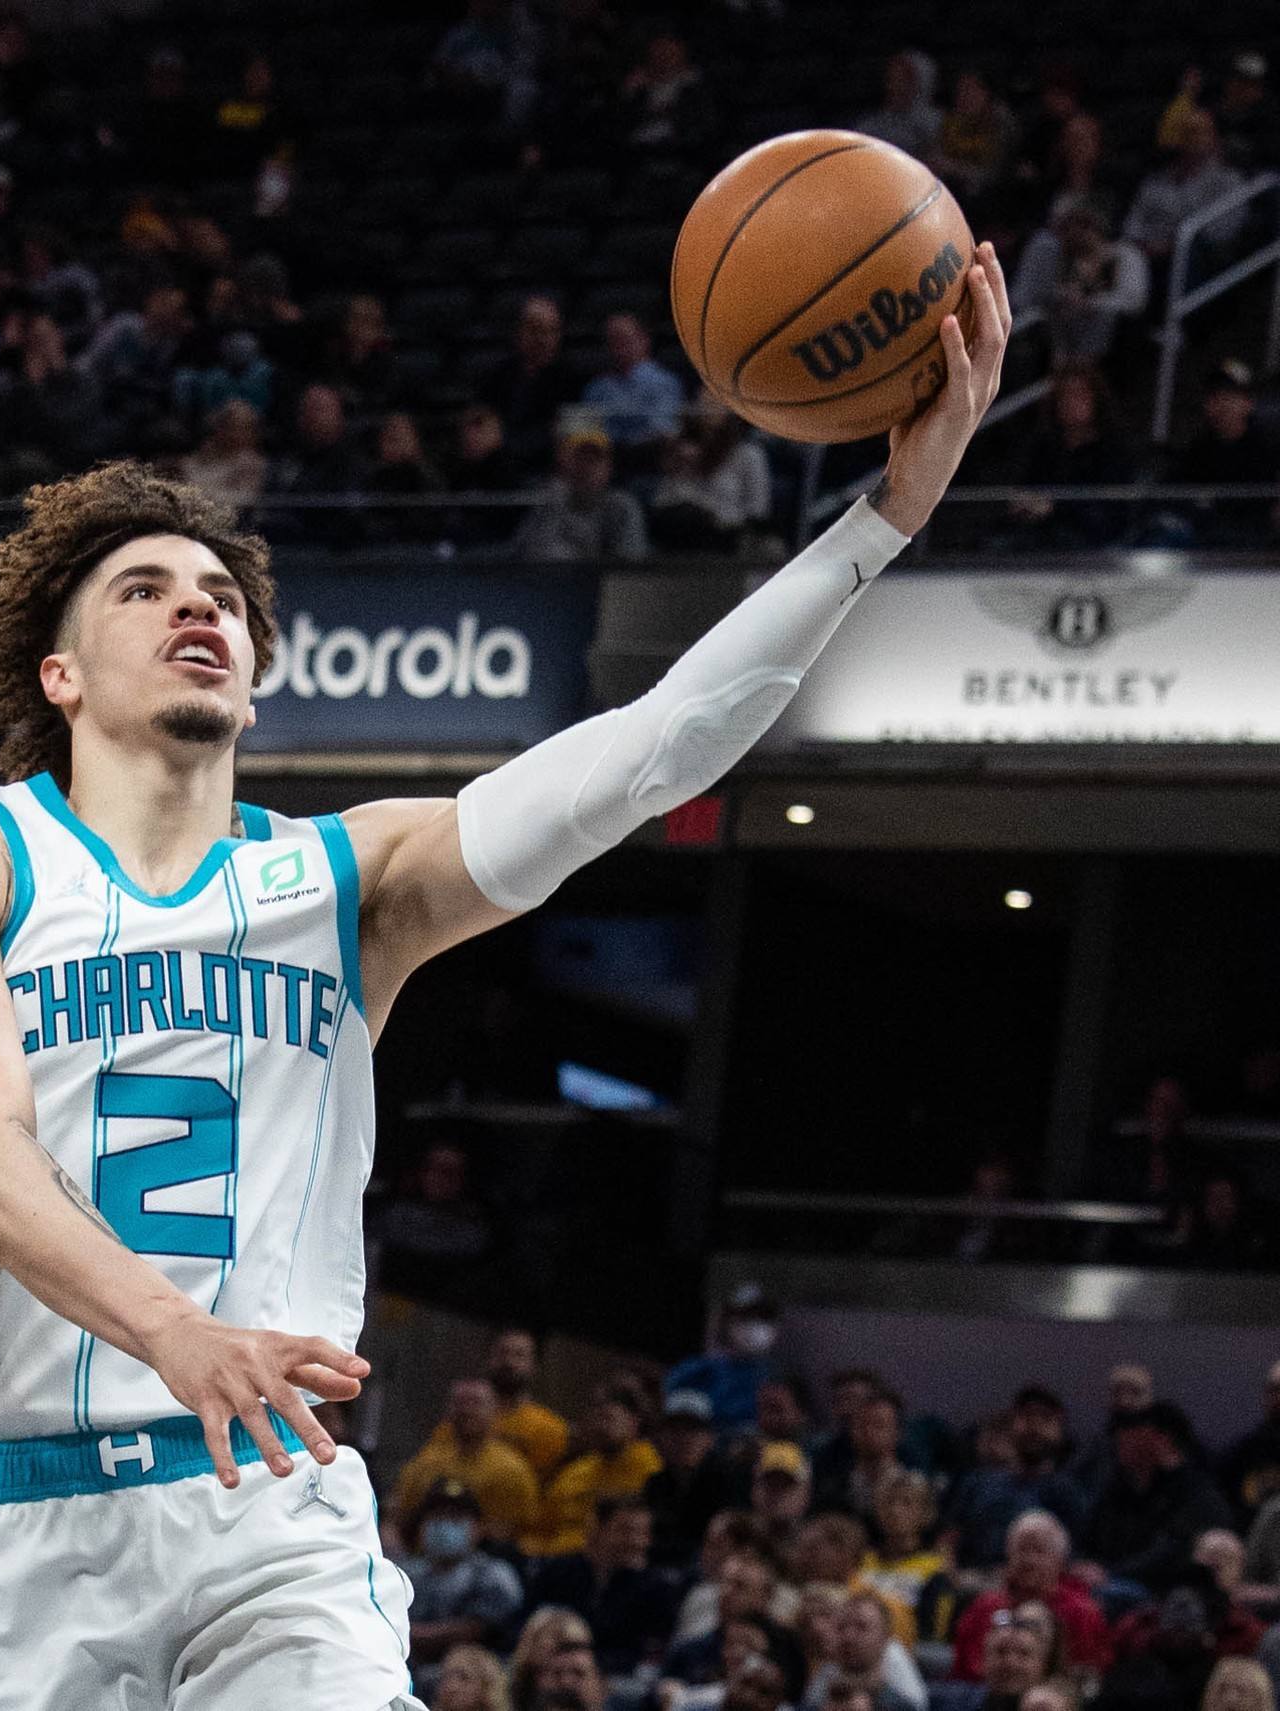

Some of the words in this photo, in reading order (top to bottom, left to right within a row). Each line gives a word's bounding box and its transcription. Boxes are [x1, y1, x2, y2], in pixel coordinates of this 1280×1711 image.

[791, 241, 964, 382] Wilson
[964, 669, 1178, 704] BENTLEY
[256, 886, 320, 905] lendingtree
[6, 950, 337, 1060] CHARLOTTE
[96, 1072, 238, 1260] 2
